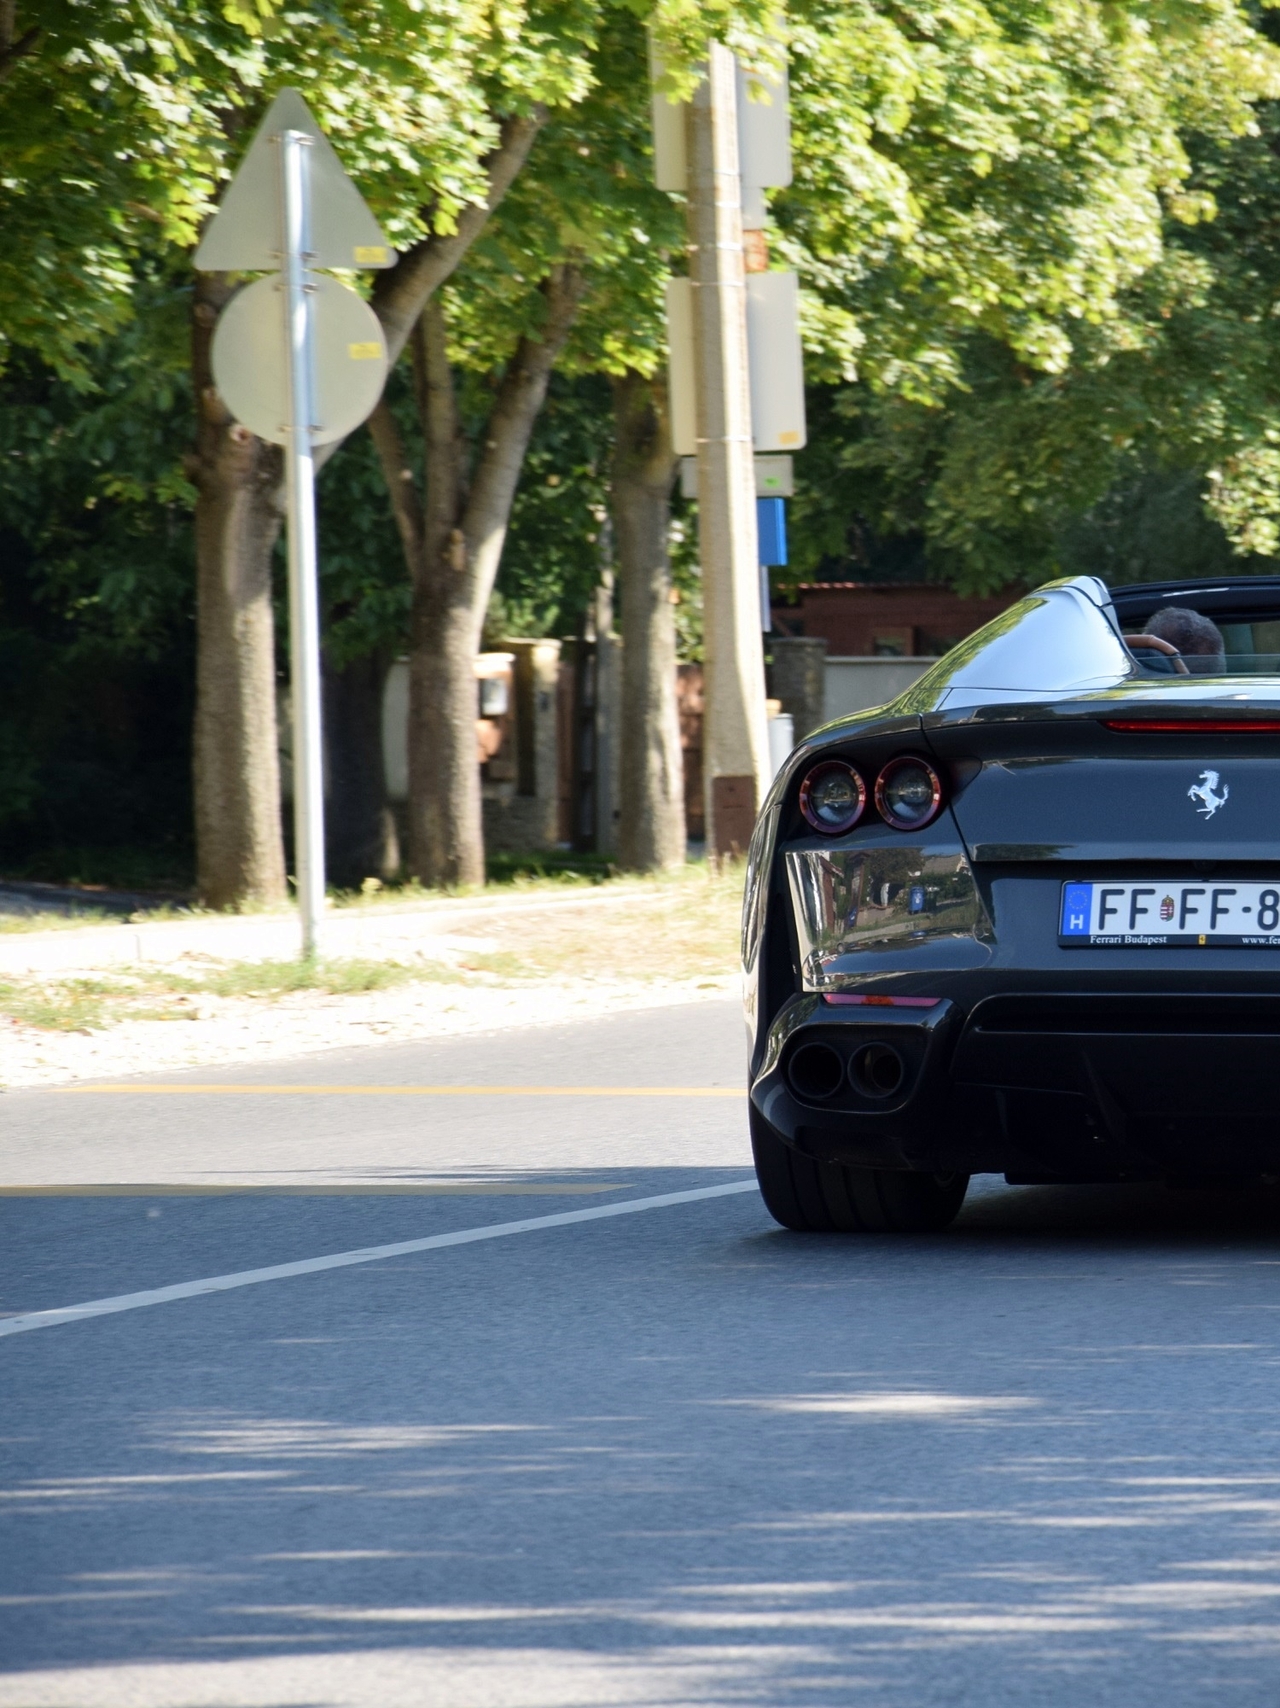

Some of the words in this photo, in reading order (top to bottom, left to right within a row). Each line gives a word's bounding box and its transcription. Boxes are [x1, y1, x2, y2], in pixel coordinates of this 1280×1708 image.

[1070, 914, 1084, 930] H
[1090, 935, 1122, 944] Ferrari
[1124, 935, 1168, 946] Budapest
